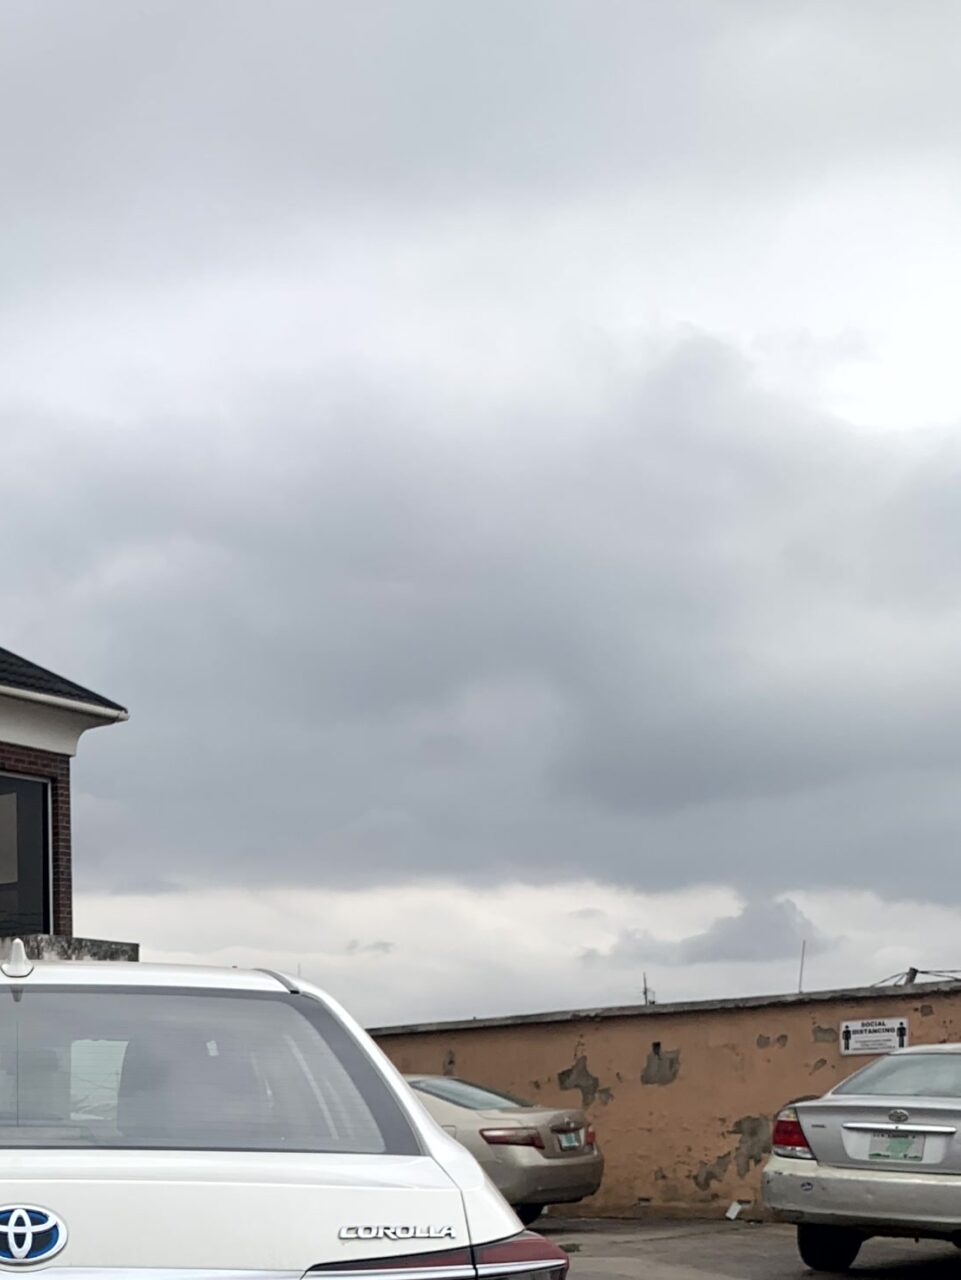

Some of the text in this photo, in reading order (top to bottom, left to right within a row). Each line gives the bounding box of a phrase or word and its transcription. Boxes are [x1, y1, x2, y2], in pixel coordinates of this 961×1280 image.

[861, 1020, 886, 1028] SOCIAL
[851, 1026, 896, 1035] DISTANCING
[338, 1225, 456, 1240] COROLLA
